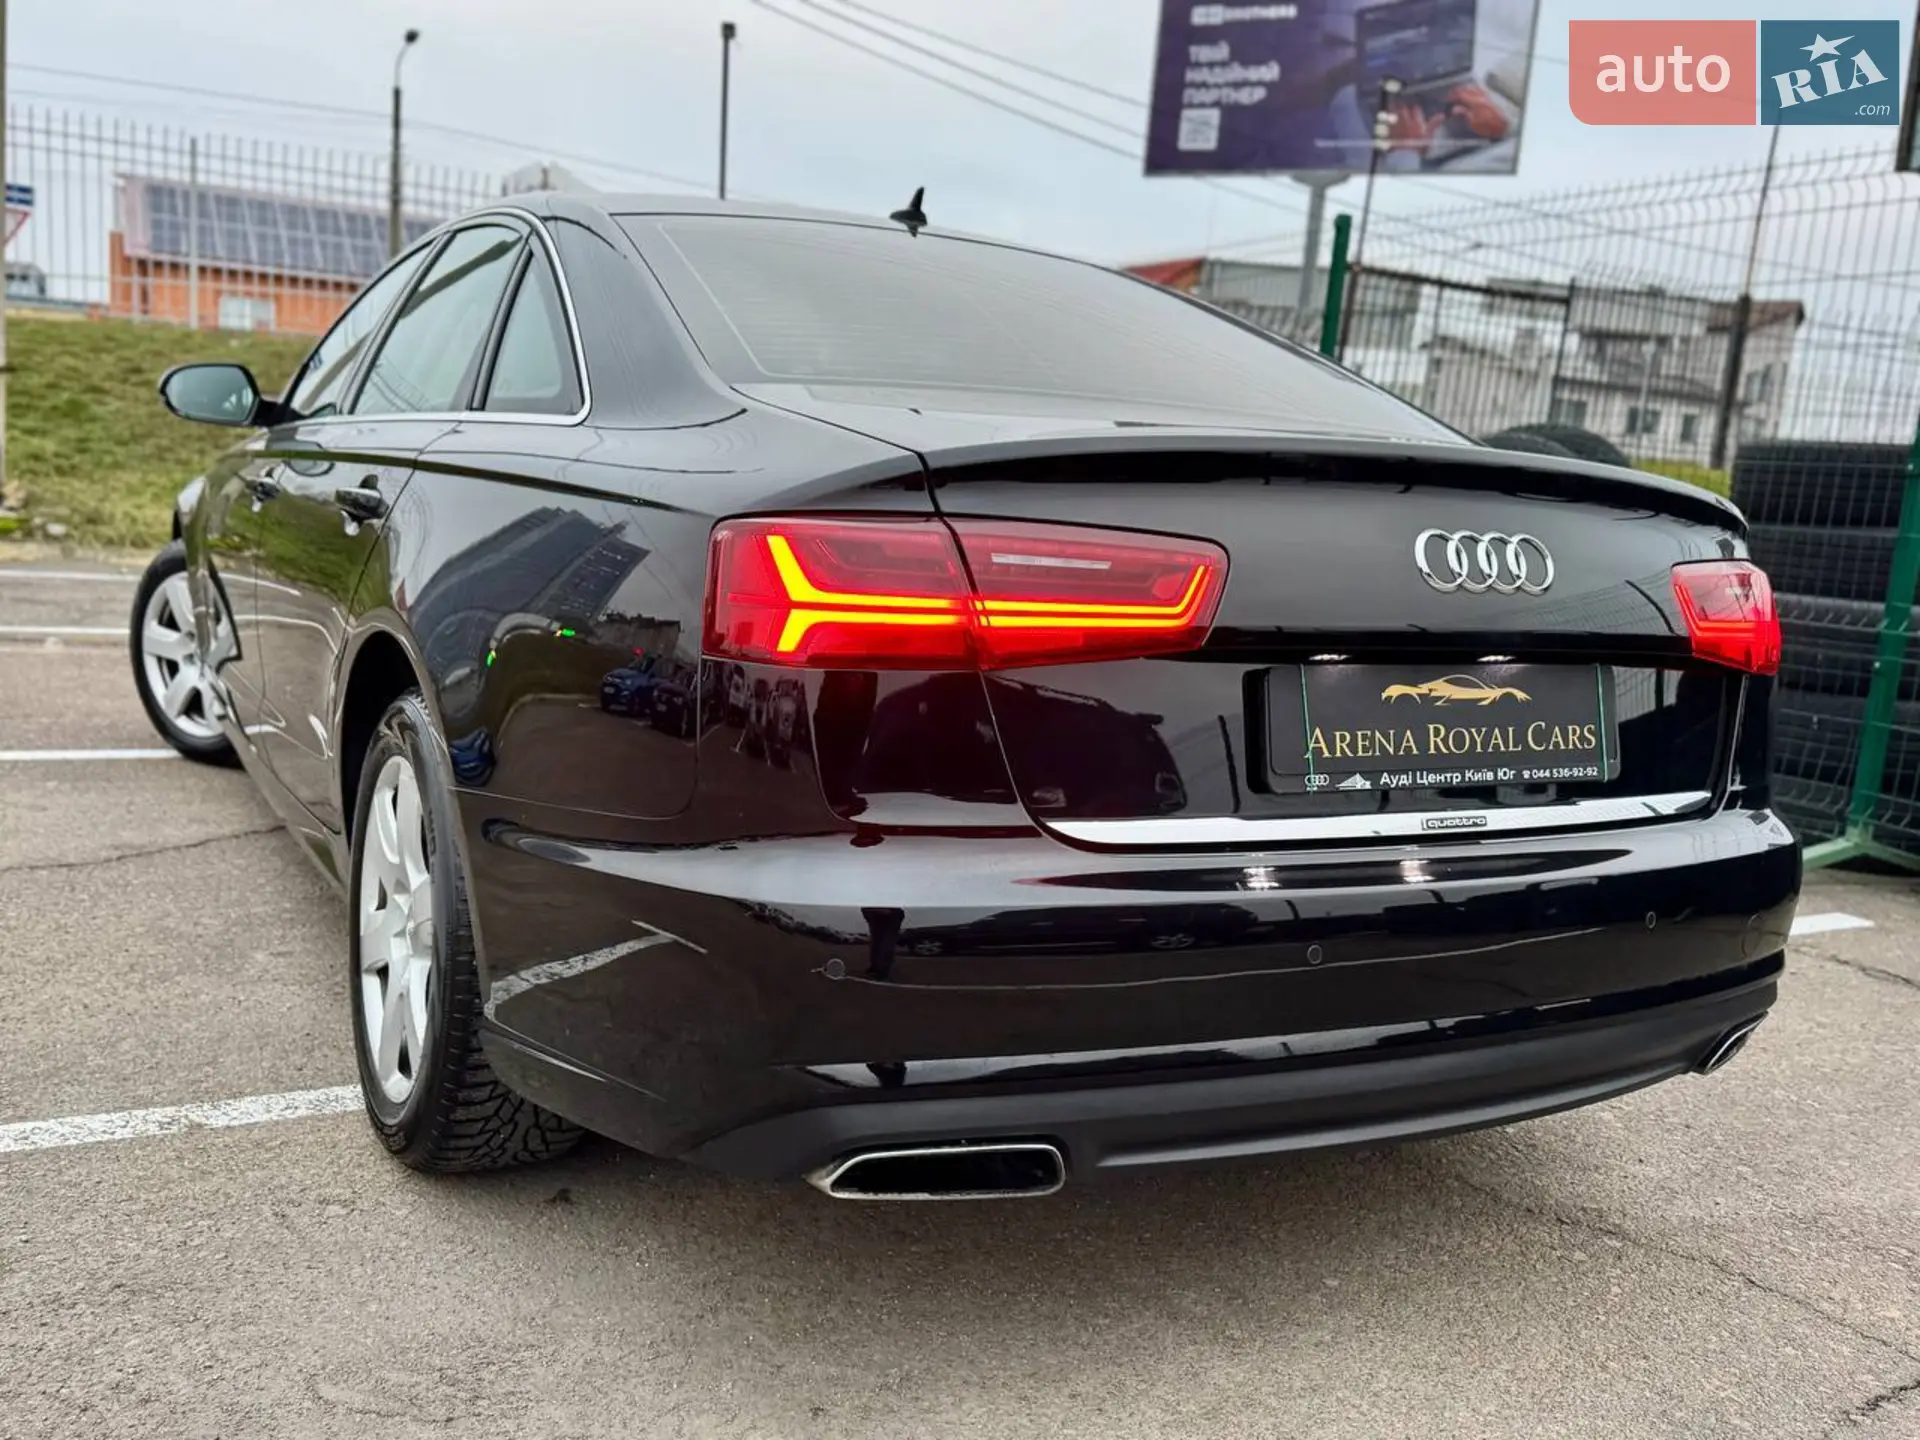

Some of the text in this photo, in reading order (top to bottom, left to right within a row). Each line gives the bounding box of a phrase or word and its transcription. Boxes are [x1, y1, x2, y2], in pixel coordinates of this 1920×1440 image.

[1303, 721, 1597, 758] ARENA ROYAL CARS
[1379, 766, 1599, 788] Ауді Центр Київ Юг 044 536-92-92
[1427, 817, 1487, 829] quattro
